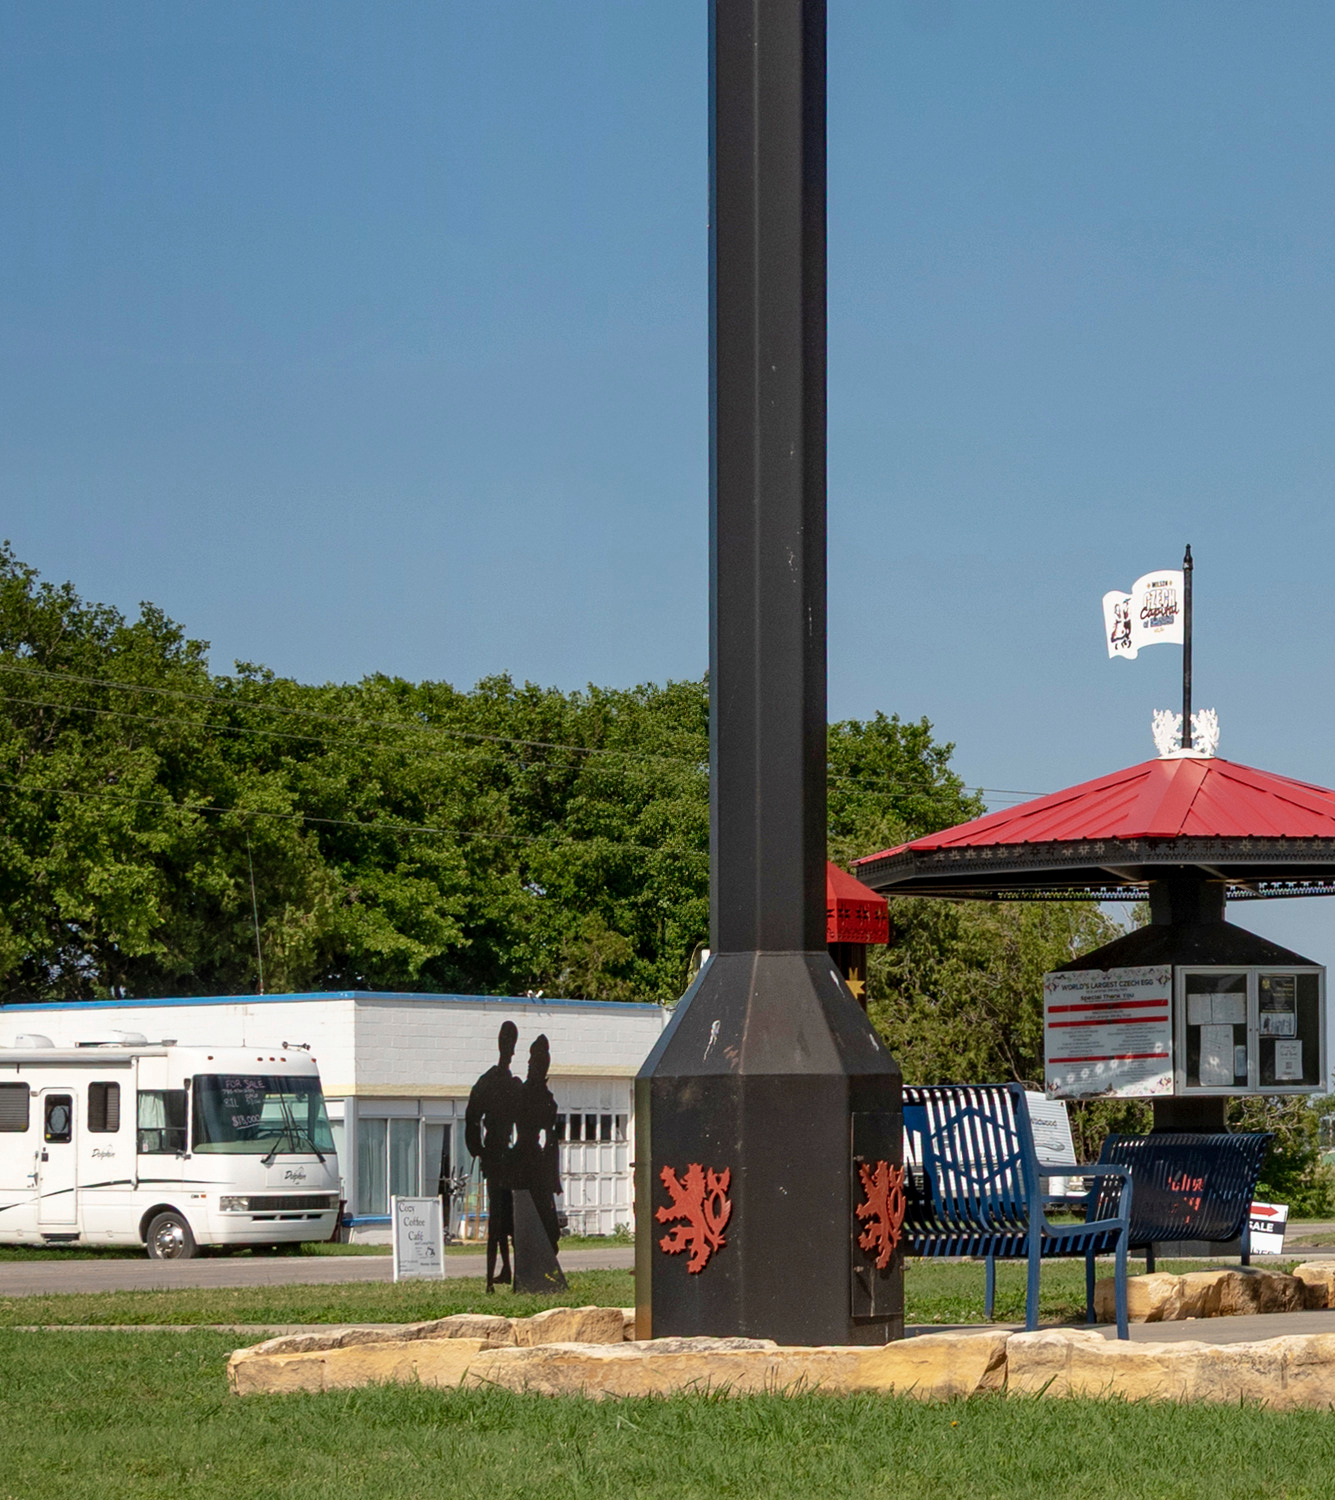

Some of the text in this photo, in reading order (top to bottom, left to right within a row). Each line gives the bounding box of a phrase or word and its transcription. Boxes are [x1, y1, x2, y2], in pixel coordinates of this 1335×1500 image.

[1143, 589, 1176, 609] CZECH
[1140, 601, 1179, 620] Capital
[1061, 982, 1090, 991] WORLD'S
[1091, 980, 1118, 989] LARGEST
[1119, 979, 1140, 988] CZECH
[225, 1079, 266, 1089] FOR SALE
[403, 1216, 425, 1226] Coffee
